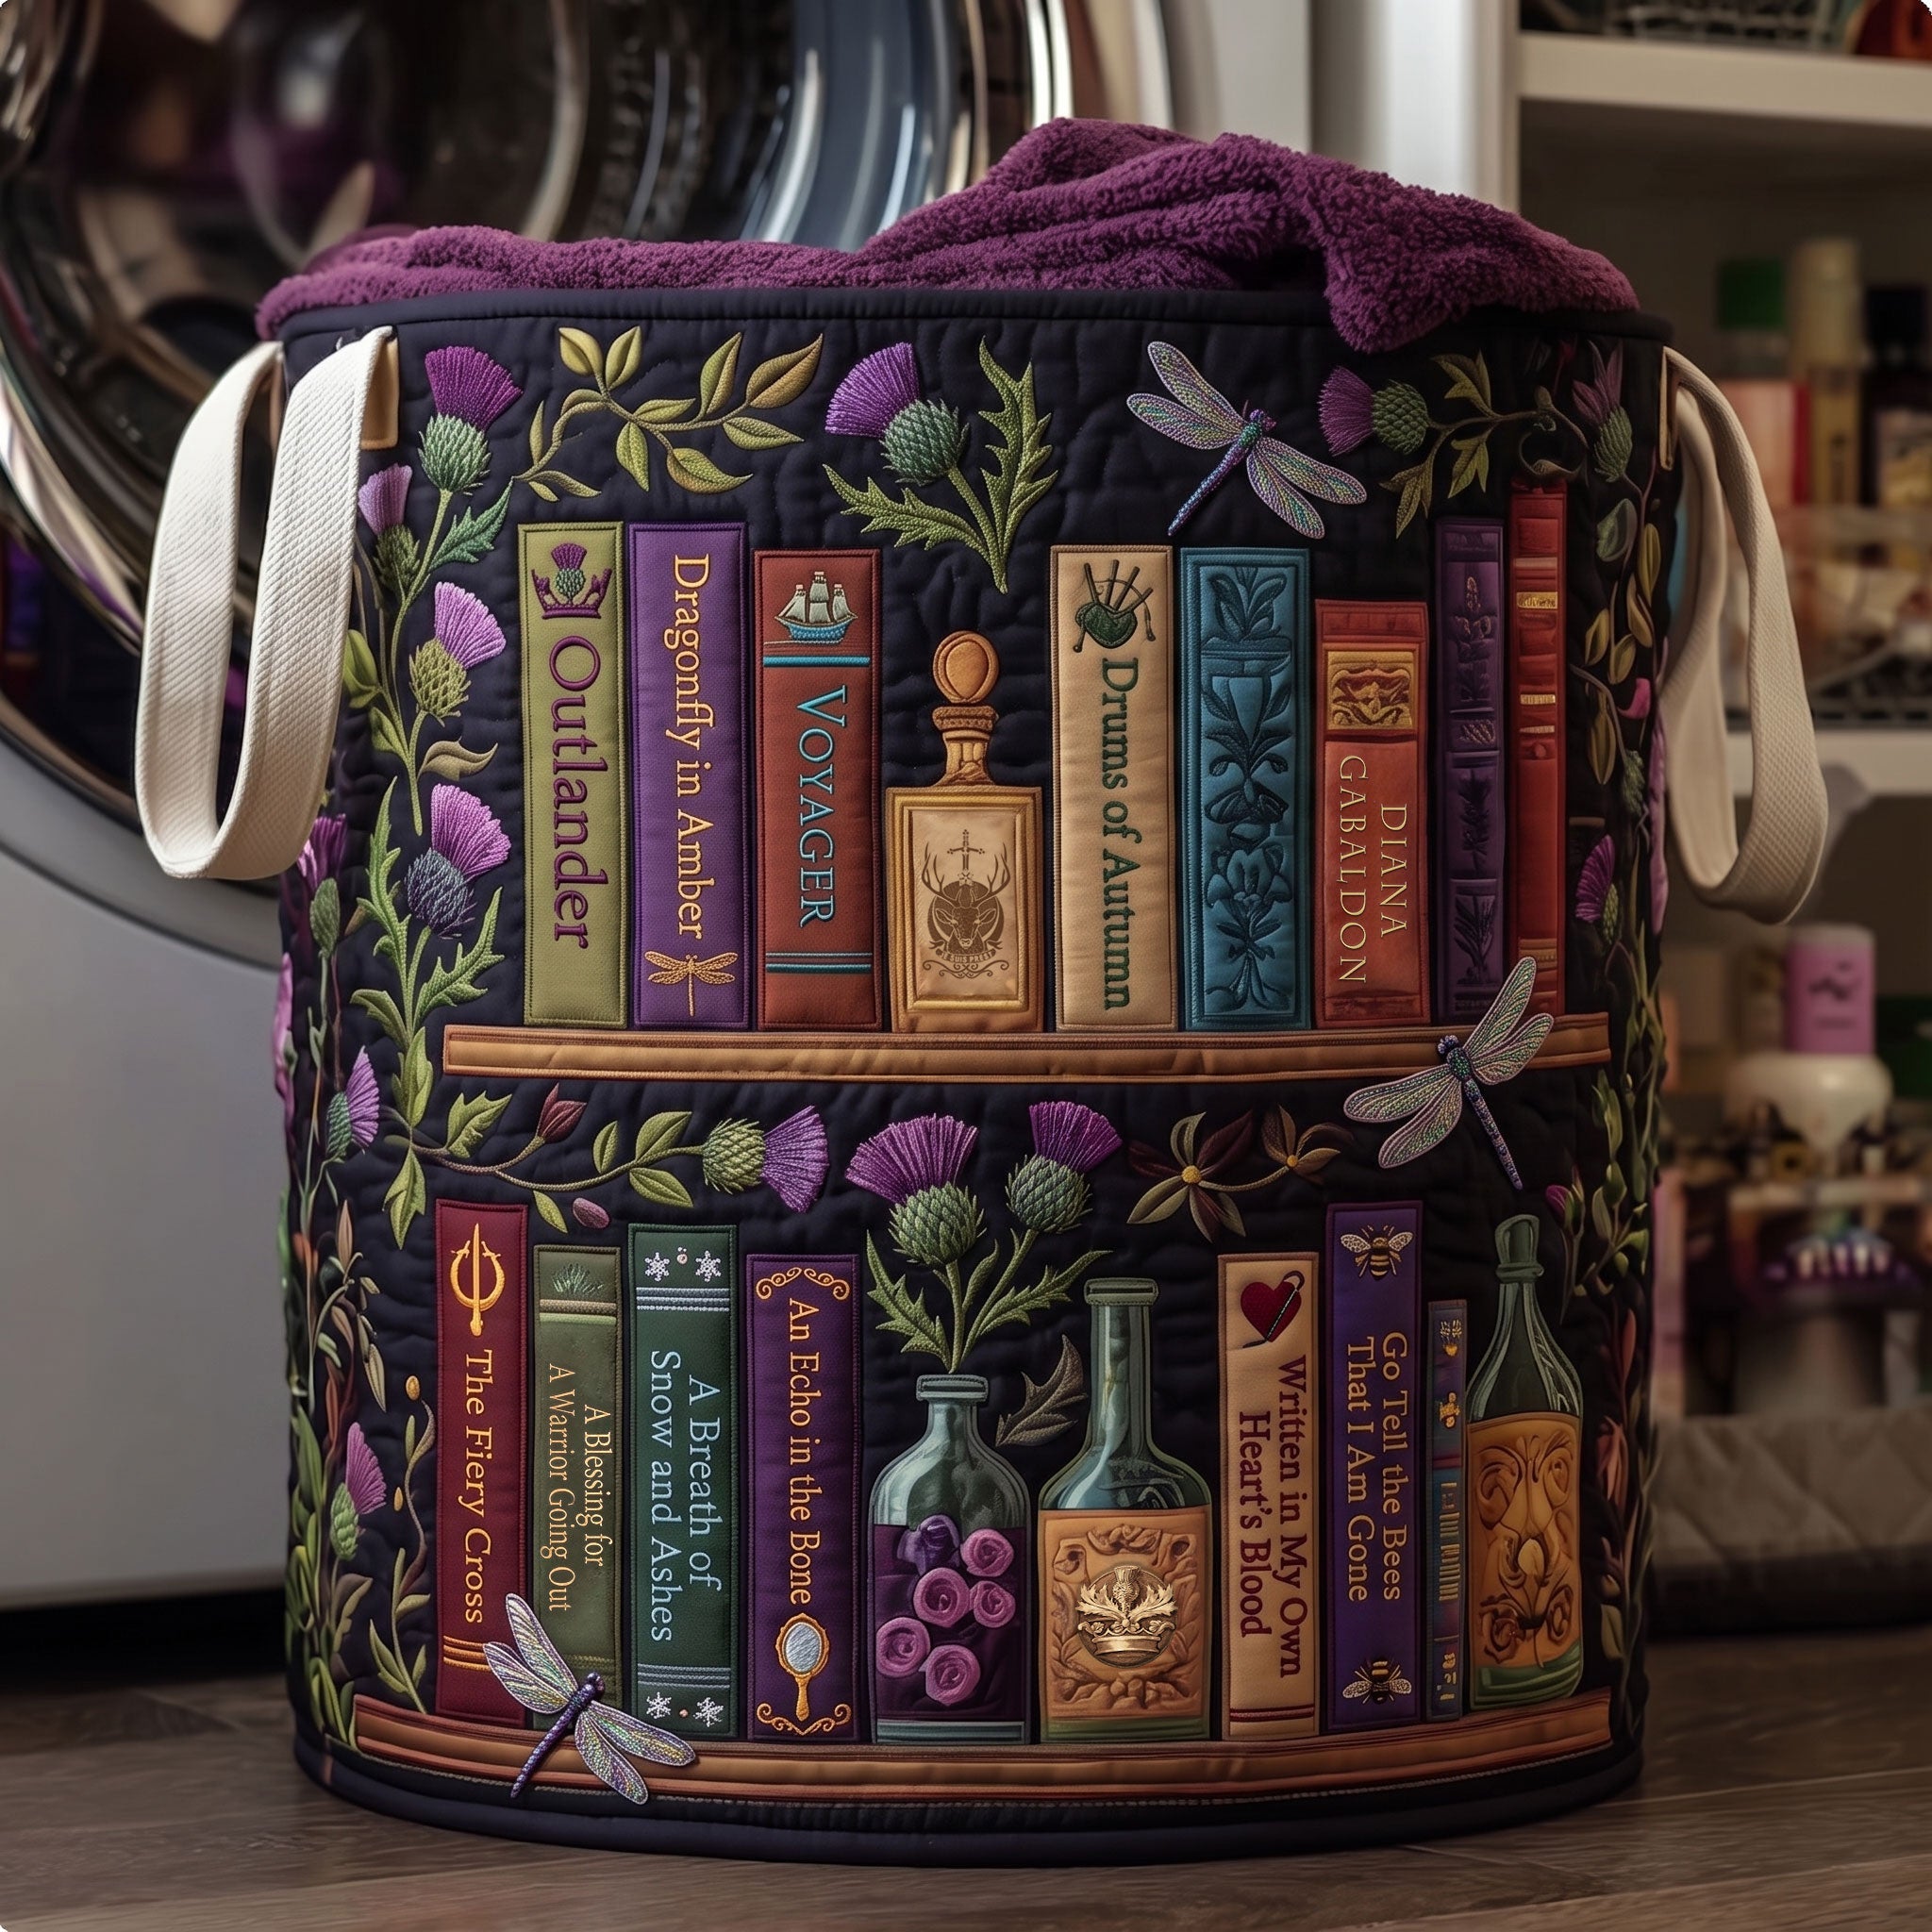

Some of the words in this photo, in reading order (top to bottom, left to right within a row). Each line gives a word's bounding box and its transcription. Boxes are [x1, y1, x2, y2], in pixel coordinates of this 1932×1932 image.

[664, 555, 716, 751] Dragonfly
[1102, 658, 1139, 789] Drums
[549, 636, 608, 948] Outlander
[677, 759, 712, 797] in
[797, 686, 847, 927] VOYAGER
[1103, 801, 1141, 844] of
[677, 810, 716, 939] Amber
[1339, 756, 1367, 983] GABALDON
[1380, 805, 1407, 938] DIANA
[1104, 849, 1141, 1010] Autumn
[790, 1298, 819, 1341] An
[1383, 1331, 1407, 1380] Go
[466, 1349, 492, 1415] The
[550, 1363, 575, 1383] A
[651, 1350, 682, 1448] Snow
[690, 1374, 720, 1406] A
[790, 1352, 821, 1427] Echo
[1347, 1337, 1374, 1411] That
[549, 1389, 575, 1481] Warrior
[585, 1405, 610, 1424] A
[791, 1437, 822, 1465] in
[1279, 1355, 1307, 1483] Written
[1347, 1423, 1374, 1433] I
[1382, 1391, 1408, 1453] Tell
[458, 1427, 492, 1517] Fiery
[575, 1432, 613, 1526] Blessing
[652, 1460, 682, 1524] and
[689, 1419, 724, 1536] Breath
[790, 1474, 822, 1525] the
[1279, 1491, 1307, 1523] in
[1347, 1443, 1374, 1503] Am
[1382, 1462, 1409, 1514] the
[540, 1488, 575, 1560] Going
[584, 1531, 613, 1567] for
[1270, 1531, 1307, 1588] My
[1347, 1514, 1374, 1602] Gone
[464, 1527, 492, 1624] Cross
[549, 1568, 575, 1612] Out
[651, 1537, 683, 1641] Ashes
[689, 1545, 723, 1591] of
[790, 1532, 821, 1604] Bone
[1239, 1541, 1272, 1636] Blood
[1383, 1525, 1407, 1601] Bees
[1279, 1591, 1308, 1678] Own
